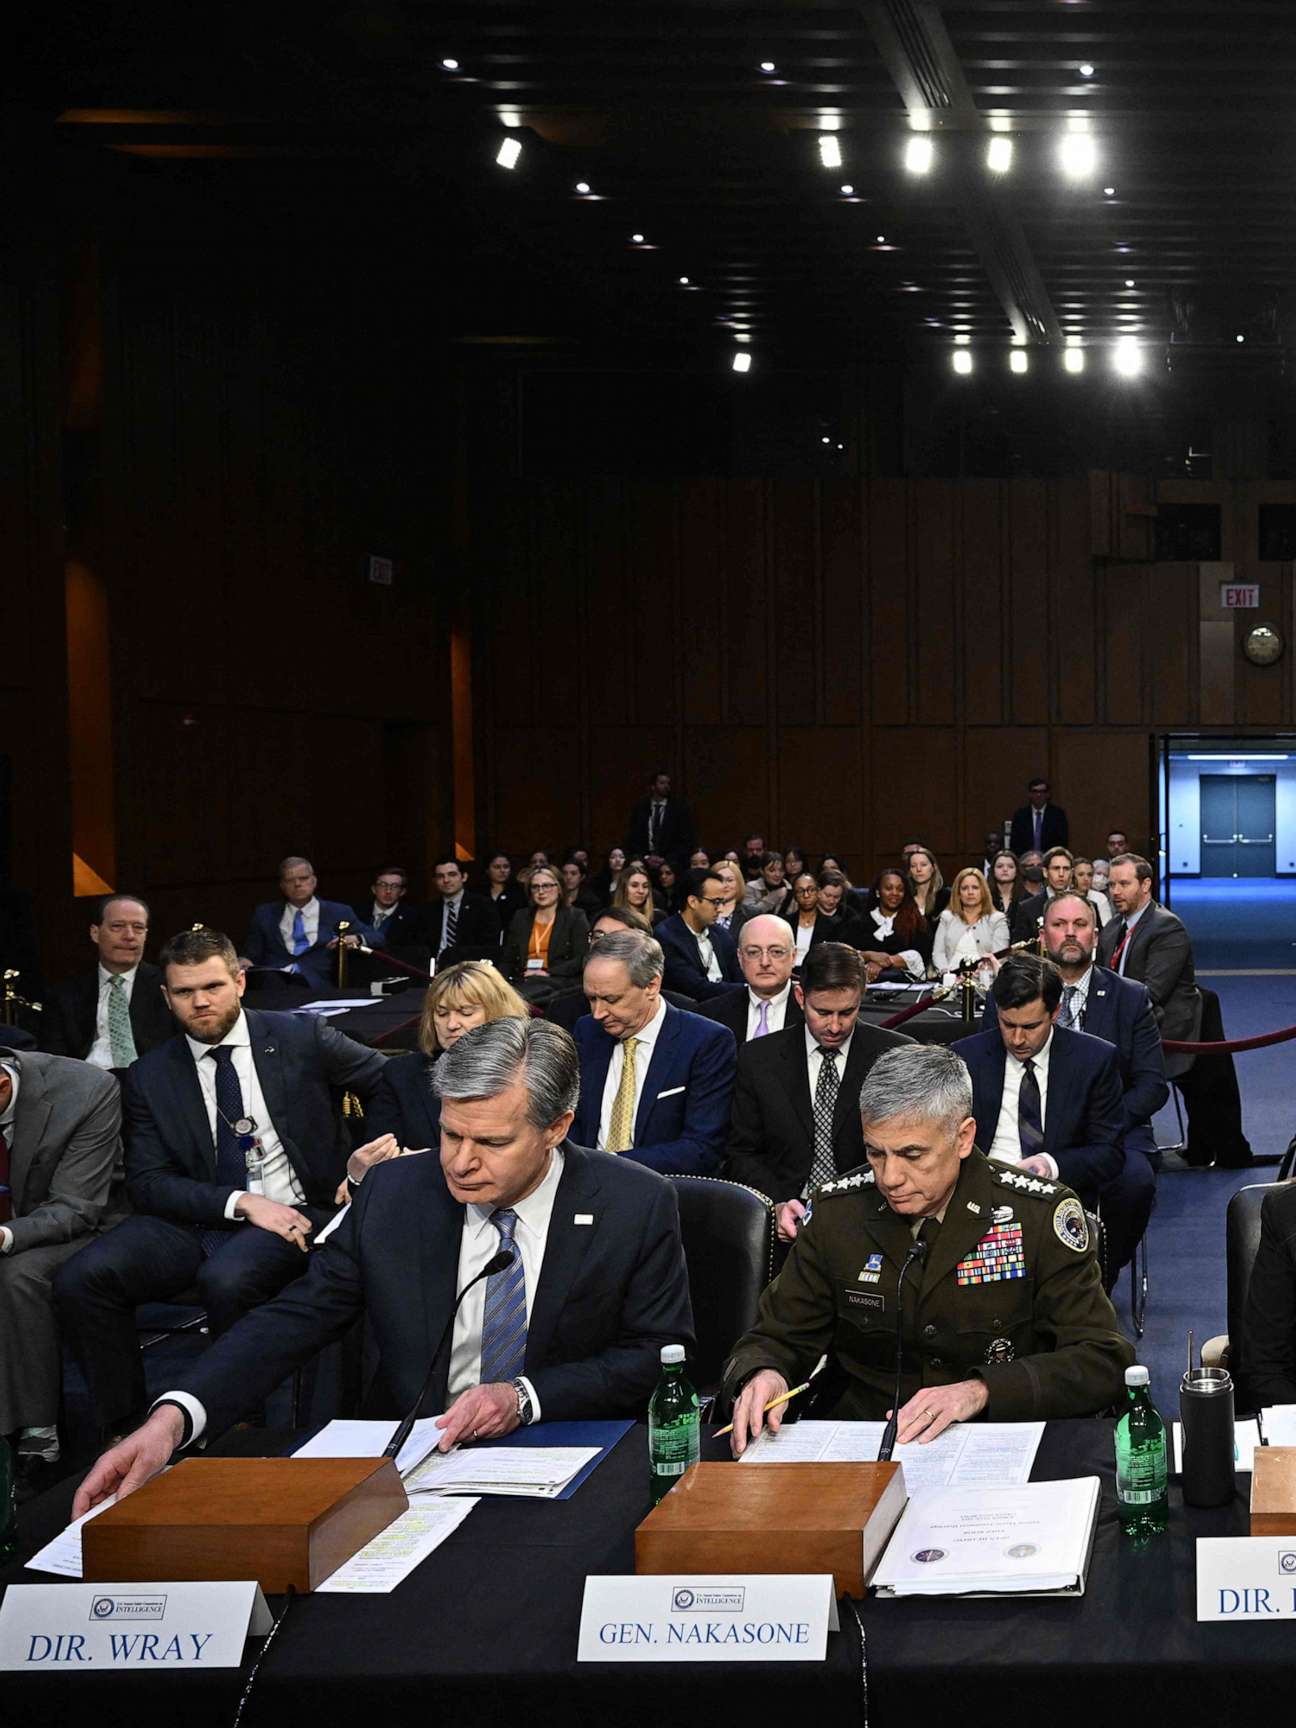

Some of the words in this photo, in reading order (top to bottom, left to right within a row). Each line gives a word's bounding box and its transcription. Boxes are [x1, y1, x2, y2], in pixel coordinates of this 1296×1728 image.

[1225, 588, 1255, 606] EXIT
[848, 1295, 881, 1308] NAKASONE
[1218, 1588, 1280, 1614] DIR.
[599, 1623, 658, 1644] GEN.
[667, 1623, 810, 1644] NAKASONE
[25, 1634, 93, 1661] DIR.
[109, 1633, 213, 1662] WRAY
